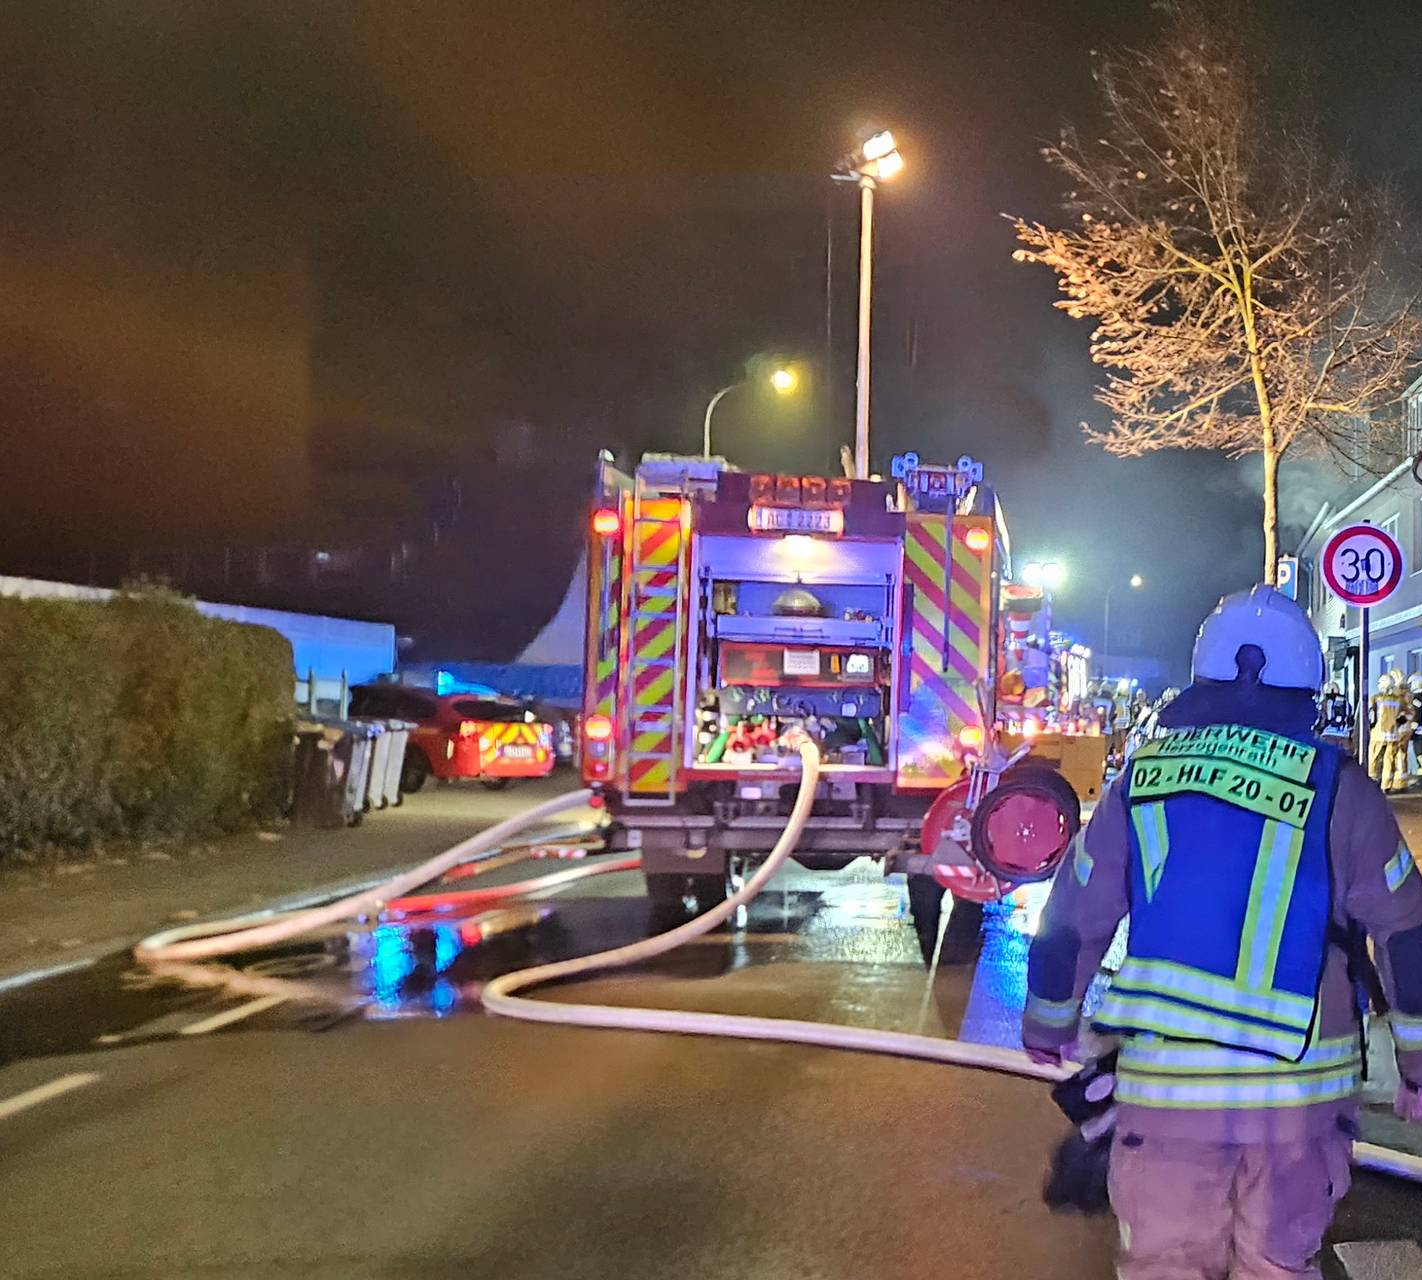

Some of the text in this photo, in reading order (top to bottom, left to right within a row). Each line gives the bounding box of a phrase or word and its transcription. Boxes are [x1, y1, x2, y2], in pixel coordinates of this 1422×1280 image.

[1277, 563, 1291, 588] P
[1341, 548, 1385, 582] 30
[1134, 767, 1162, 788] 02
[1176, 765, 1227, 785] HLF
[1228, 774, 1261, 800] 20
[1279, 791, 1310, 818] 01
